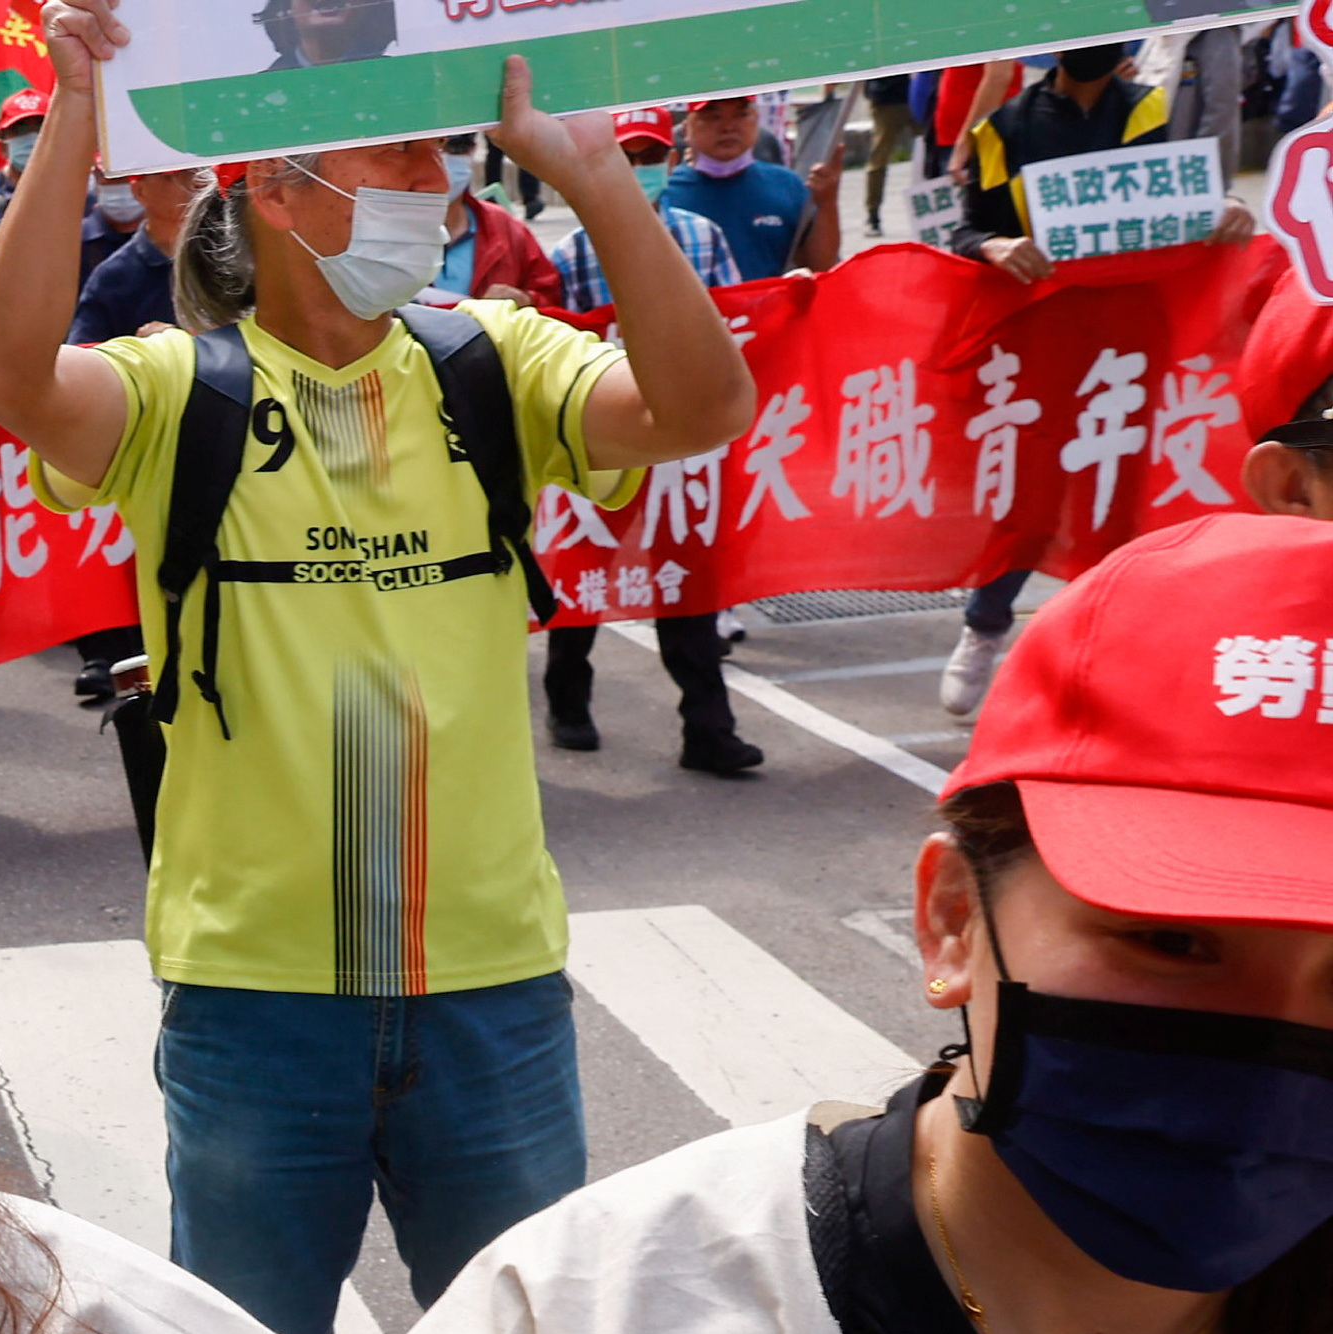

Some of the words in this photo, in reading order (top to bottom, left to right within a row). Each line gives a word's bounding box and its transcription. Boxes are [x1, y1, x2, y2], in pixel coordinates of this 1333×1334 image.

[1037, 154, 1210, 211] 執政不及格
[1046, 210, 1215, 261] 勞工算總帳
[252, 397, 296, 473] 9
[293, 562, 375, 583] SOCCE
[377, 564, 446, 592] CLUB
[1212, 634, 1333, 725] 勞
